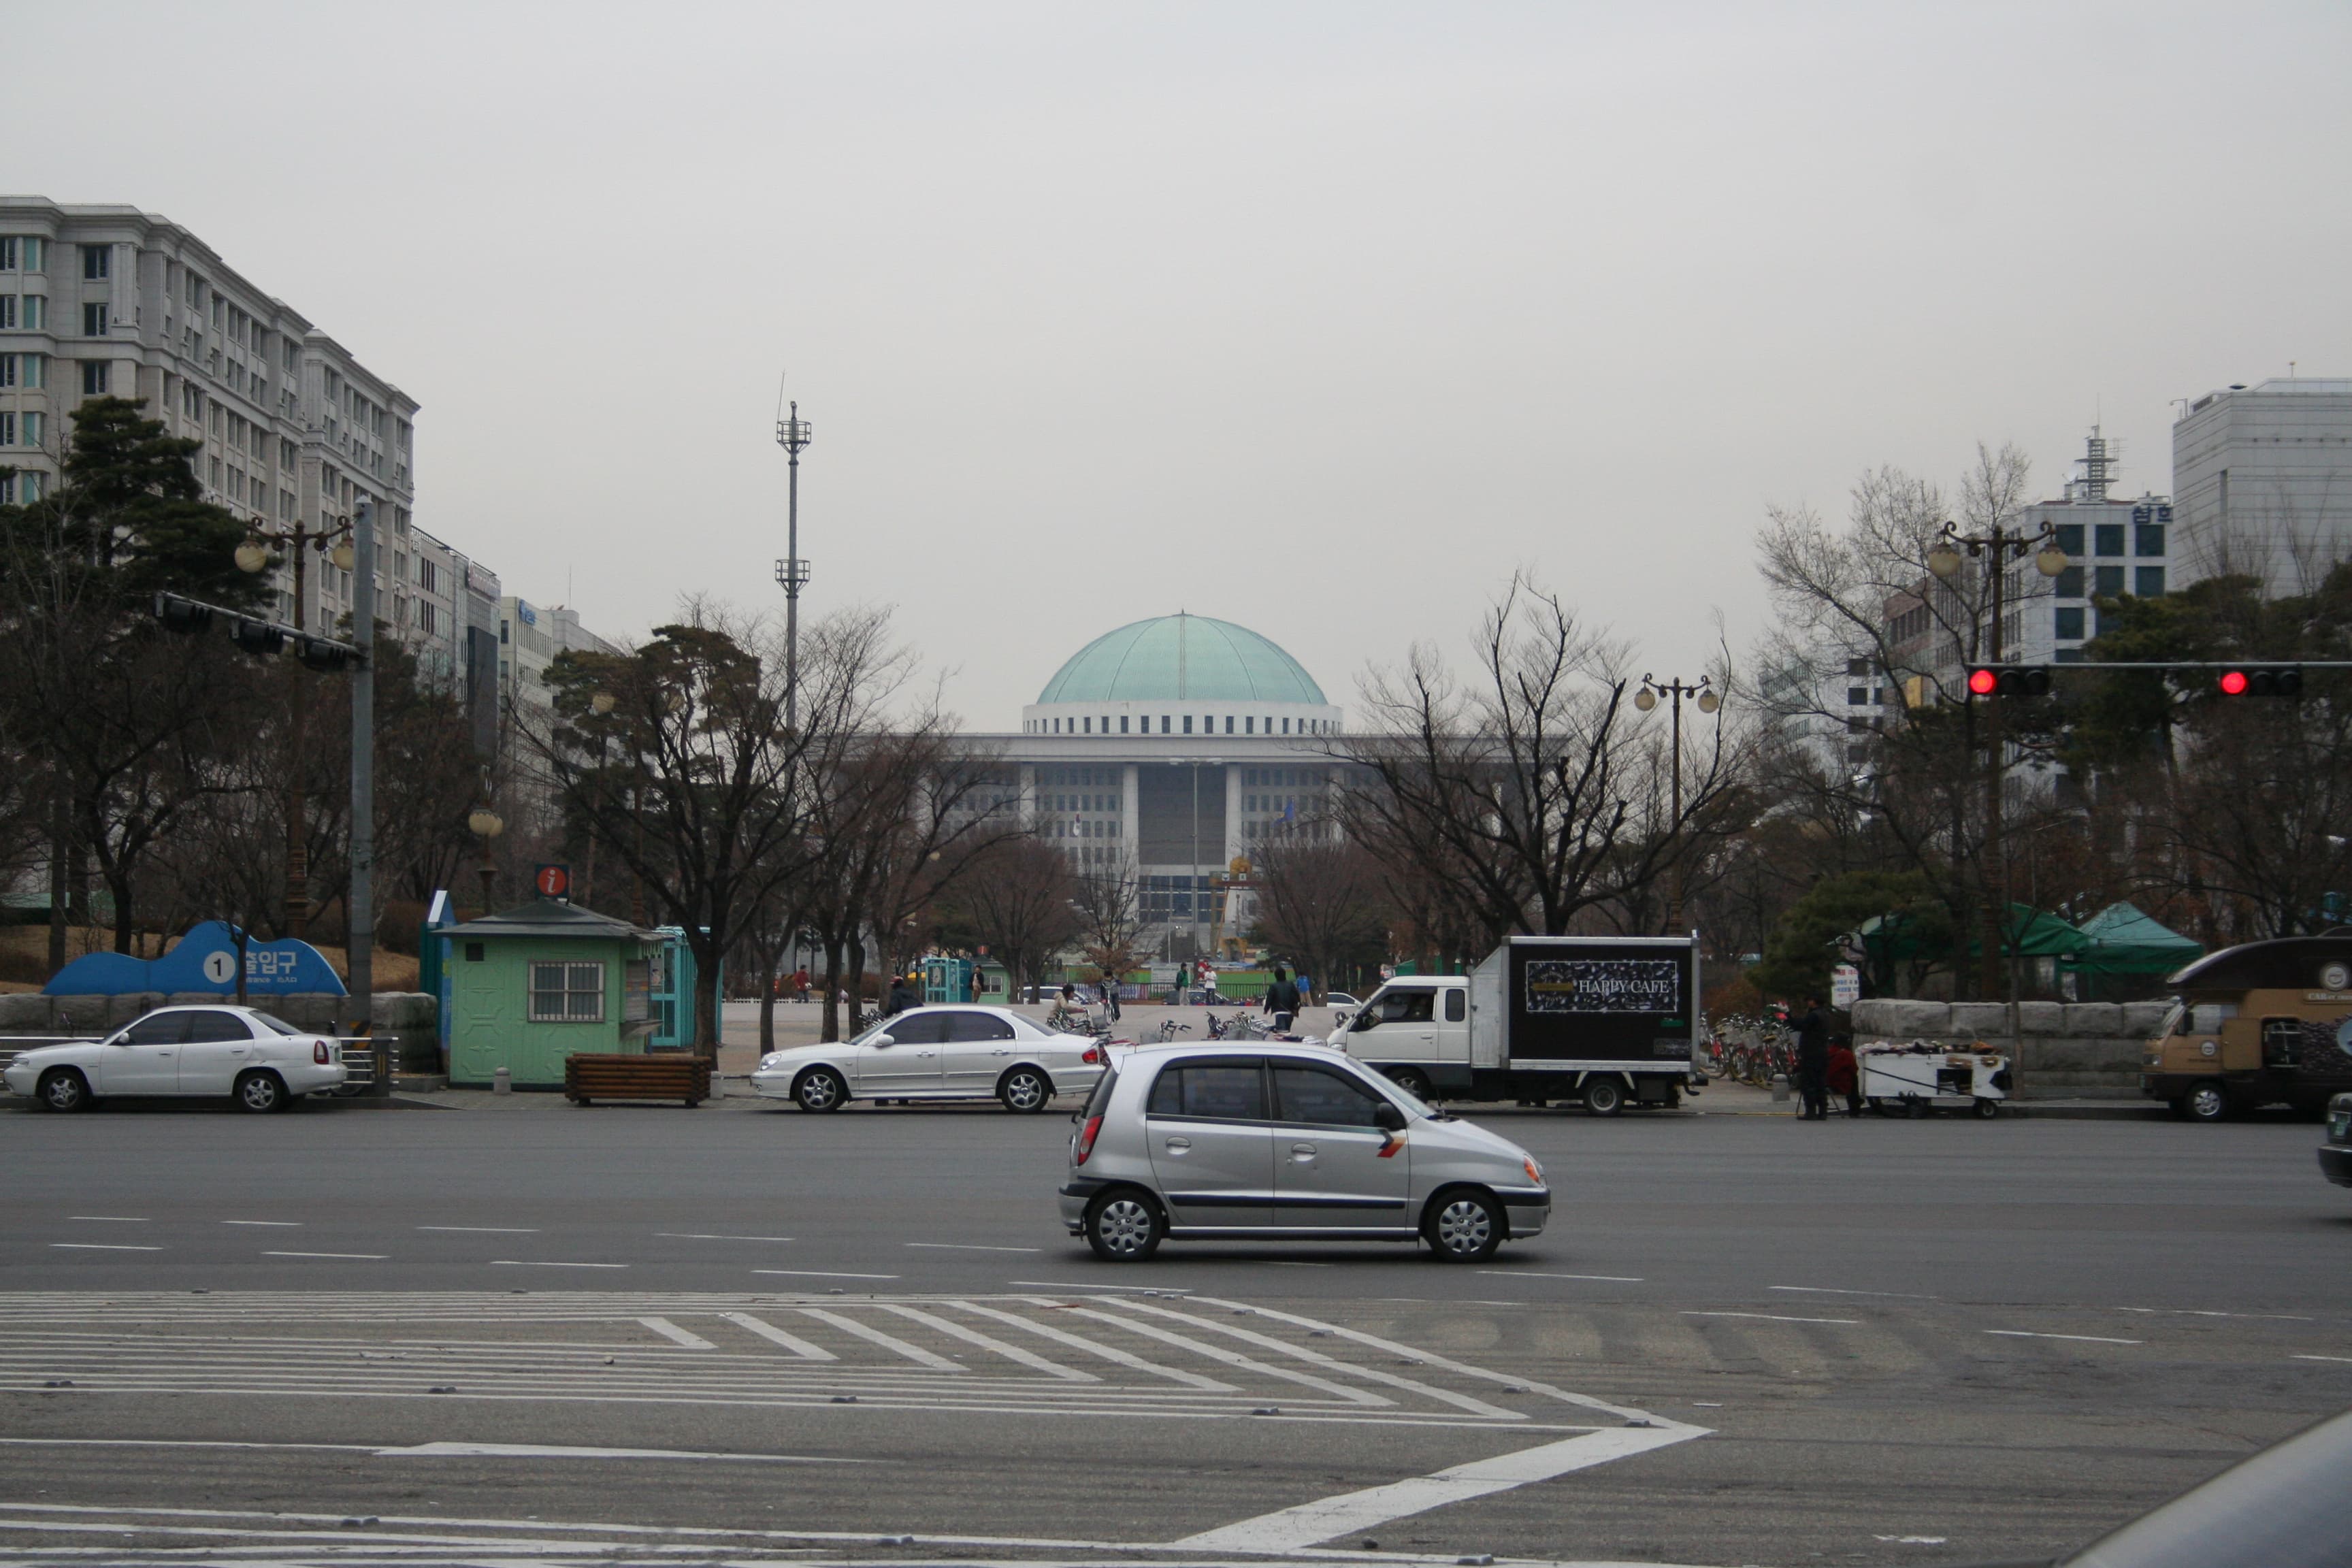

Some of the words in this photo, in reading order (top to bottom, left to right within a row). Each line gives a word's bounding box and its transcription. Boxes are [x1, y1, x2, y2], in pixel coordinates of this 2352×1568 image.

[214, 958, 222, 977] 1
[1578, 979, 1628, 994] HAPPY
[1631, 979, 1669, 994] CAFE
